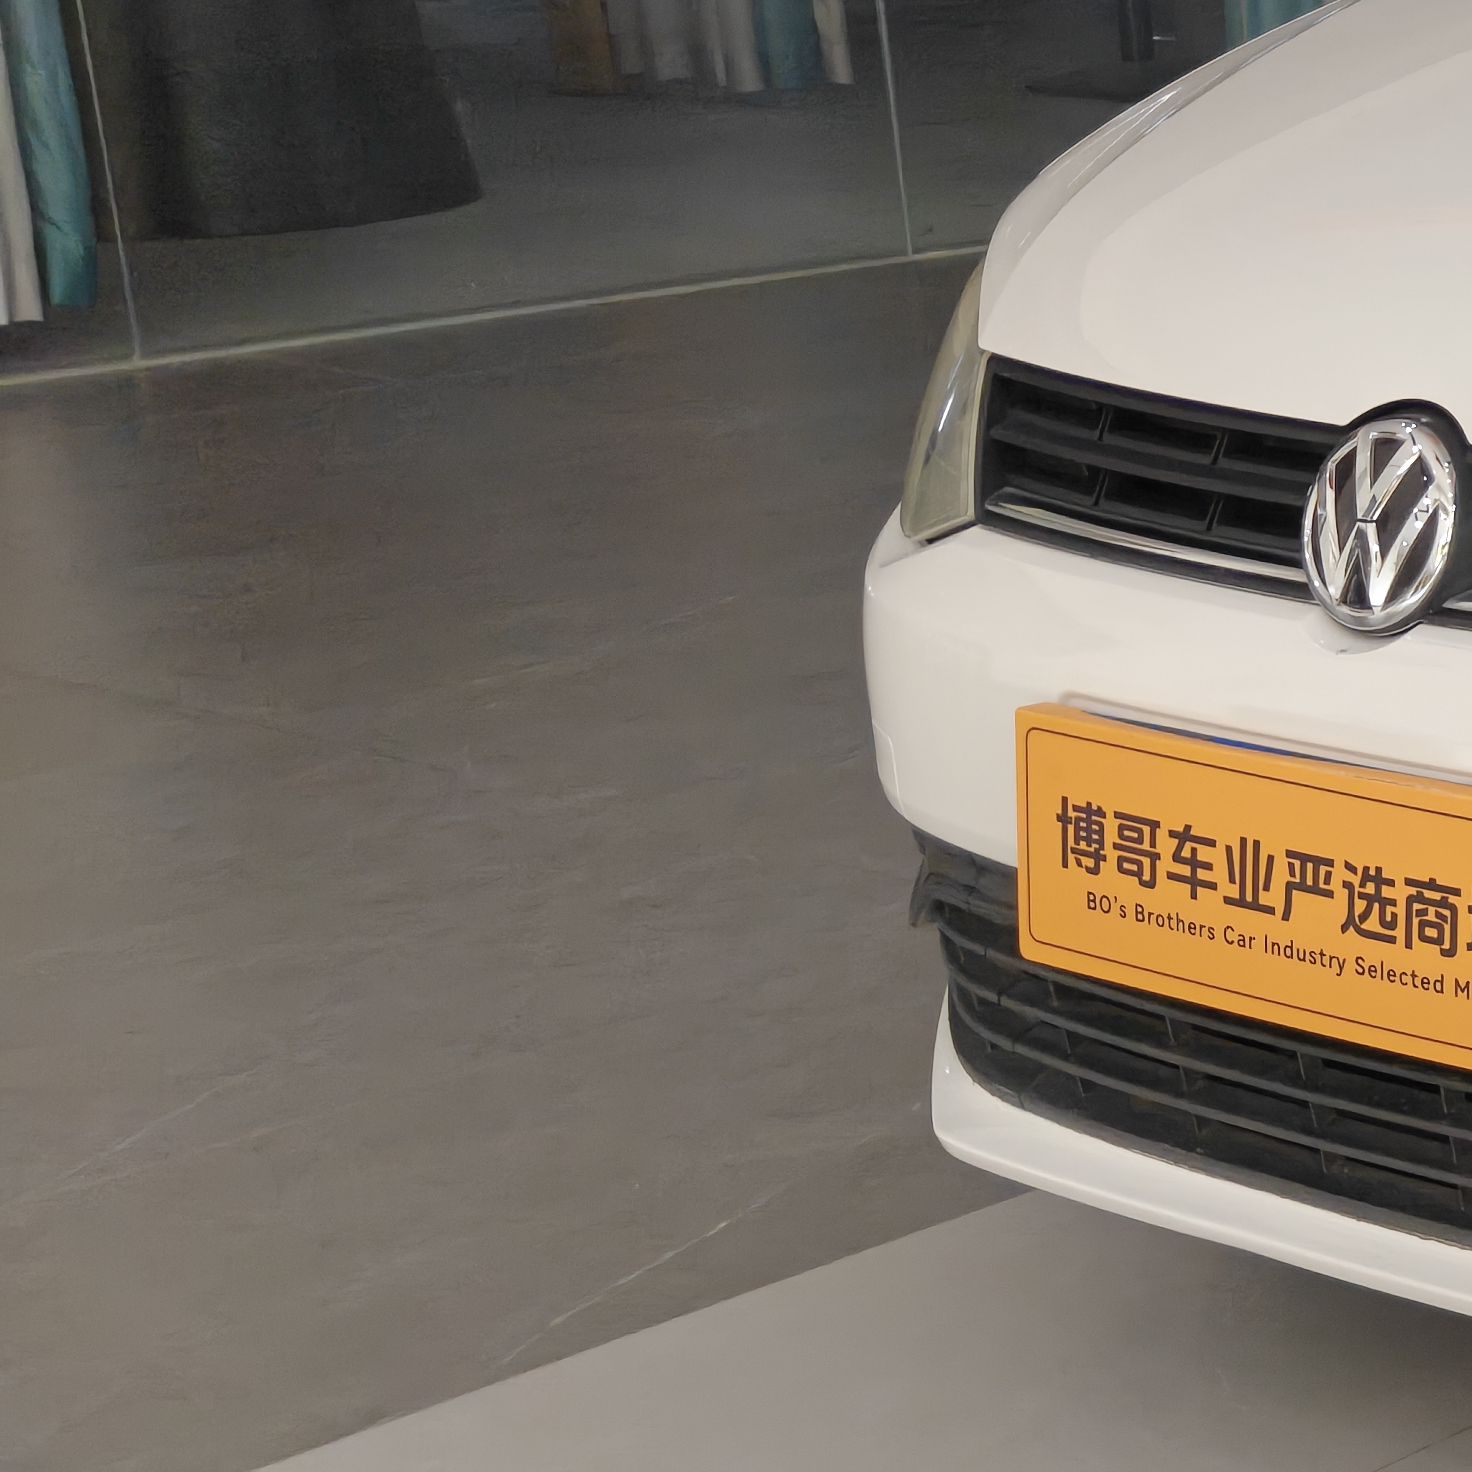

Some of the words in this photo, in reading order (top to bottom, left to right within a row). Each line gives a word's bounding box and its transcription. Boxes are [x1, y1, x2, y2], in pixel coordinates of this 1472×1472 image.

[1087, 891, 1126, 918] BO's
[1134, 902, 1216, 941] Brothers
[1223, 925, 1257, 951] Car
[1265, 935, 1346, 976] Industry
[1355, 956, 1444, 994] Selected
